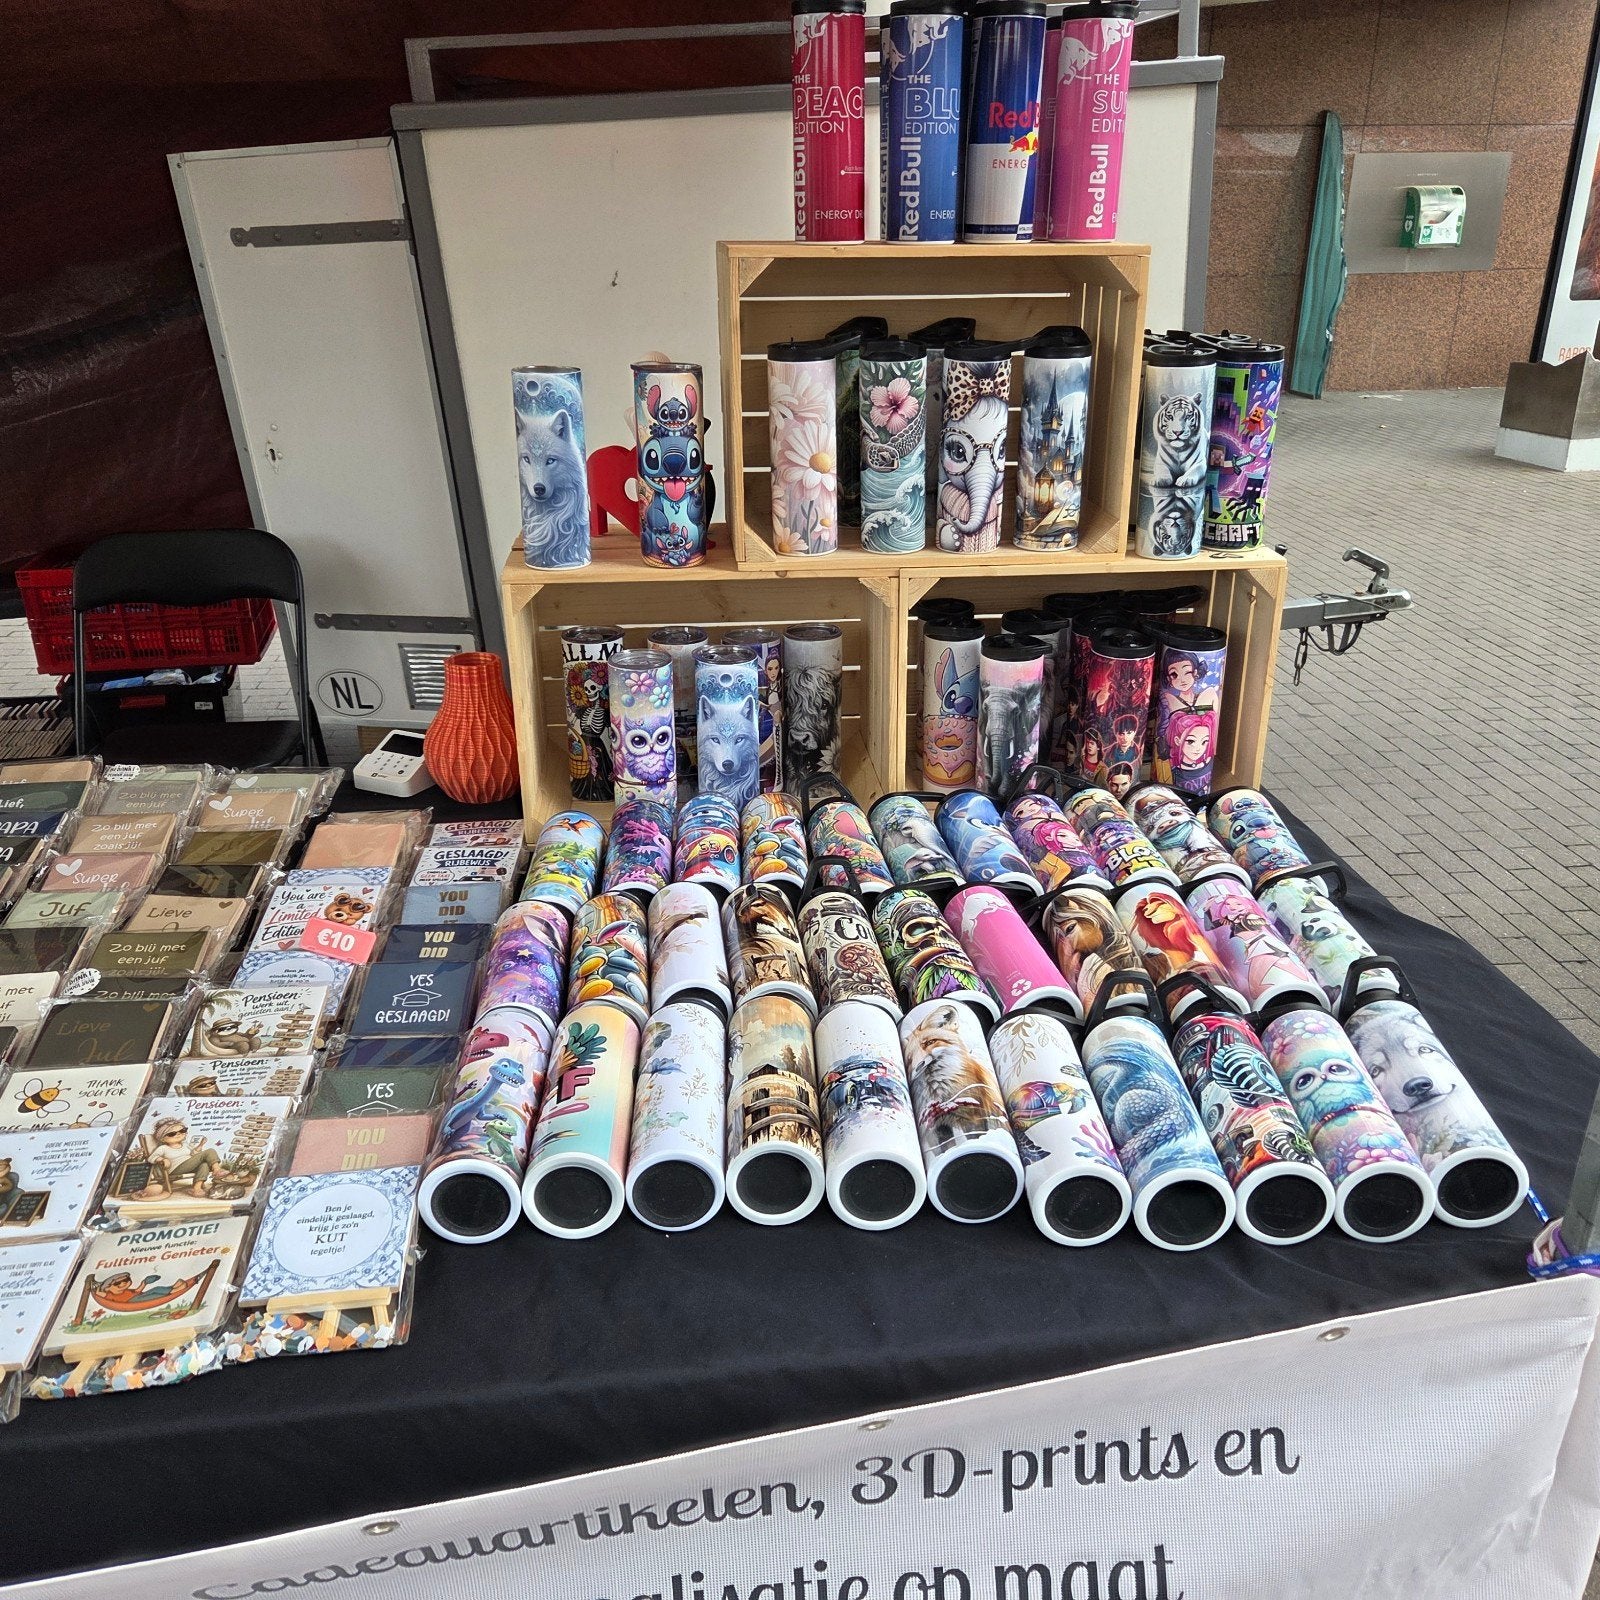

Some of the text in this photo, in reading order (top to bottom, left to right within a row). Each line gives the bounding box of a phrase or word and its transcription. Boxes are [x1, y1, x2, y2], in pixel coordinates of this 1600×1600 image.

[793, 74, 811, 84] THE
[907, 74, 932, 84] THE
[1095, 73, 1120, 85] THE
[904, 121, 957, 135] EDITION
[1086, 144, 1109, 228] Red Bull
[815, 209, 854, 220] ENERGY
[330, 676, 374, 709] NL
[0, 821, 39, 834] APA
[91, 823, 111, 832] Zo
[445, 820, 518, 832] GESLAAGD!
[99, 833, 122, 841] een
[434, 849, 510, 860] GESLAAGD!
[444, 859, 492, 867] RIJBEWIJS
[280, 890, 304, 905] You
[438, 890, 469, 902] YOU
[146, 907, 193, 919] Lieve
[265, 908, 322, 924] Limited
[437, 905, 466, 916] DID
[317, 928, 356, 952] €10
[424, 931, 456, 943] YOU
[109, 943, 187, 953] Zo blij met
[418, 947, 449, 958] DID
[117, 955, 169, 965] een juf
[409, 973, 435, 987] YES
[5, 986, 35, 996] met
[241, 991, 303, 1007] Pensioen:
[375, 1008, 451, 1023] GESLAAGD!
[209, 1058, 269, 1071] Pensioen:
[86, 1079, 125, 1089] THANK
[366, 1082, 395, 1099] YES
[186, 1099, 245, 1112] Pensioen:
[346, 1127, 386, 1146] YOU
[340, 1152, 379, 1171] DID
[325, 1203, 352, 1213] Ben je
[296, 1210, 375, 1225] eindelijk geslaagd,
[308, 1221, 359, 1232] krijg je zo'n
[117, 1222, 220, 1247] PROMOTIE!
[314, 1232, 348, 1244] KUT
[129, 1240, 198, 1254] Nieuwe functie:
[310, 1245, 346, 1256] tegeltje!
[95, 1246, 222, 1270] Fulltime Genieter
[0, 1275, 44, 1289] eester
[851, 1425, 1200, 1513] 3D-prints
[1213, 1423, 1301, 1478] en
[994, 1543, 1184, 1600] maat
